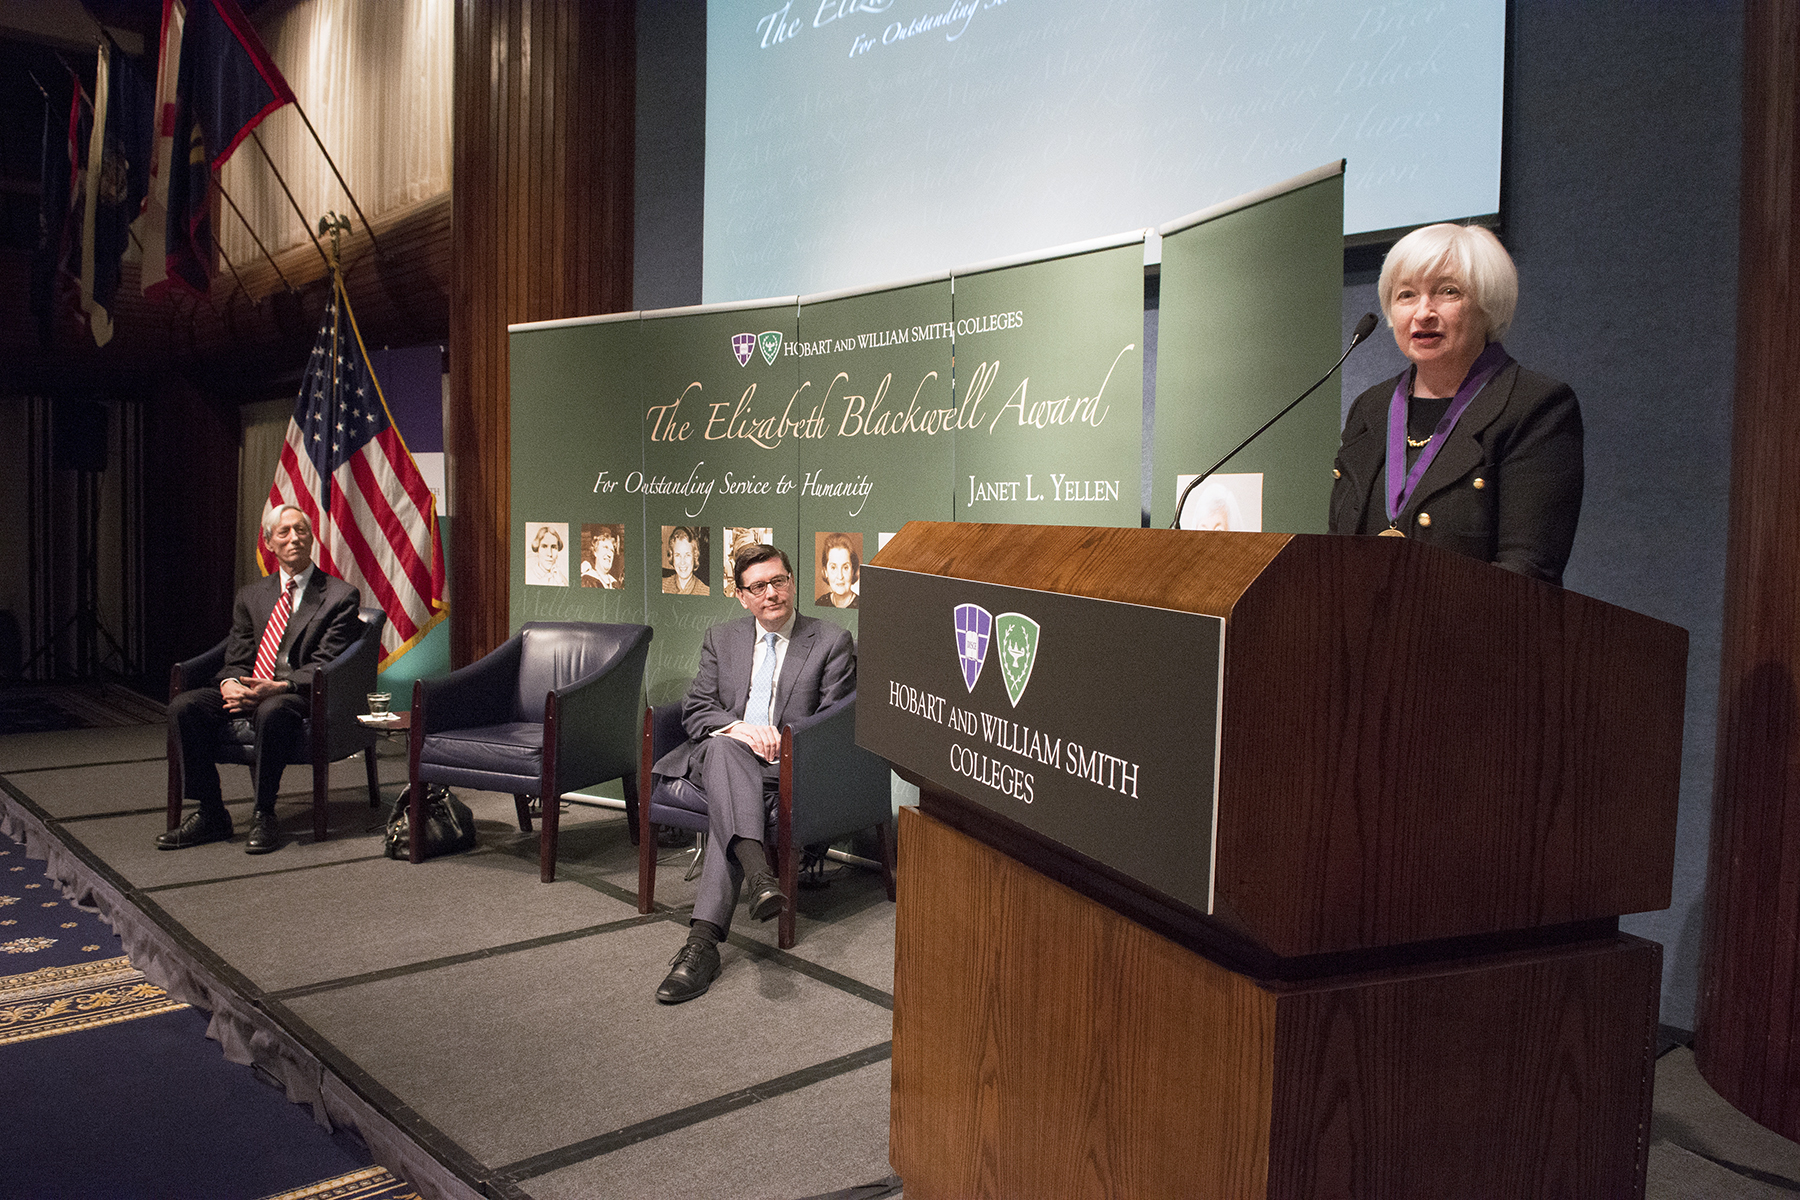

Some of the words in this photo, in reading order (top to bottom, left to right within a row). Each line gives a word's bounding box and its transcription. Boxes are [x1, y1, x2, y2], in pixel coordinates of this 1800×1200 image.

[755, 0, 804, 49] The
[848, 33, 877, 58] For
[882, 0, 980, 43] Outstanding
[783, 337, 834, 358] HOBART
[833, 337, 857, 353] AND
[857, 327, 910, 349] WILLIAM
[911, 321, 954, 342] SMITH
[956, 310, 1024, 336] COLLEGES
[646, 381, 703, 442] The
[704, 372, 849, 450] Elizabeth
[837, 360, 1000, 437] Blackwell
[989, 343, 1136, 435] Award
[593, 470, 619, 494] For
[624, 461, 716, 518] Outstanding
[719, 471, 772, 495] Service
[776, 474, 798, 495] to
[801, 468, 874, 518] Humanity
[967, 475, 1021, 507] JANET
[1025, 474, 1045, 502] L.
[1050, 473, 1120, 502] YELLEN
[889, 680, 946, 724] HOBART
[948, 706, 978, 736] AND
[980, 712, 1062, 769] WILLIAM
[1065, 742, 1140, 799] SMITH
[950, 743, 1035, 805] COLLEGES
